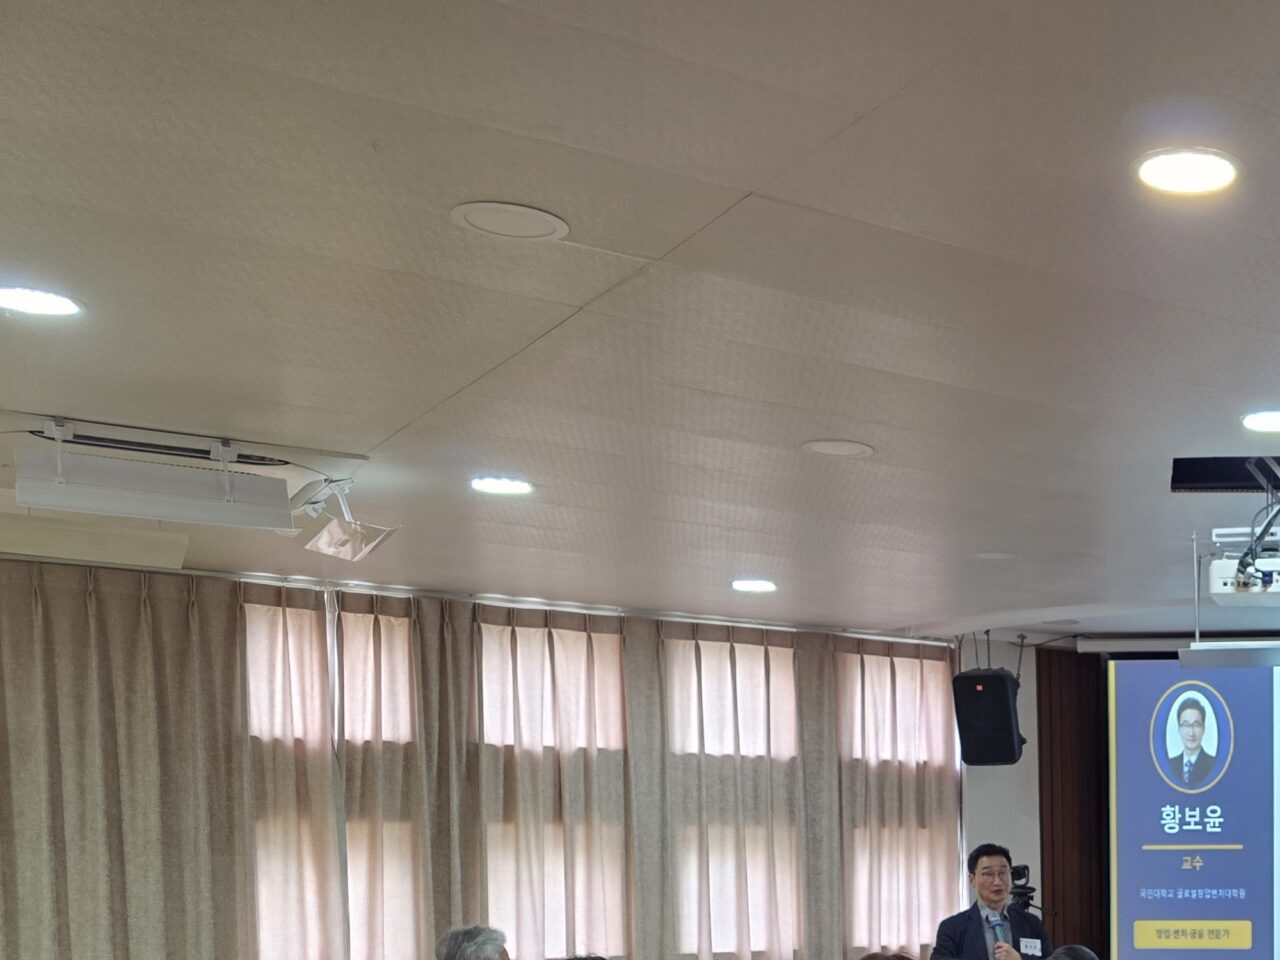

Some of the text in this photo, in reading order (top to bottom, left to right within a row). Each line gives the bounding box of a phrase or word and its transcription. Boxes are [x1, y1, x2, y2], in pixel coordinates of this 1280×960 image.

[1160, 804, 1224, 833] 황보윤
[1181, 856, 1204, 870] 교수
[1207, 928, 1231, 939] 전문가
